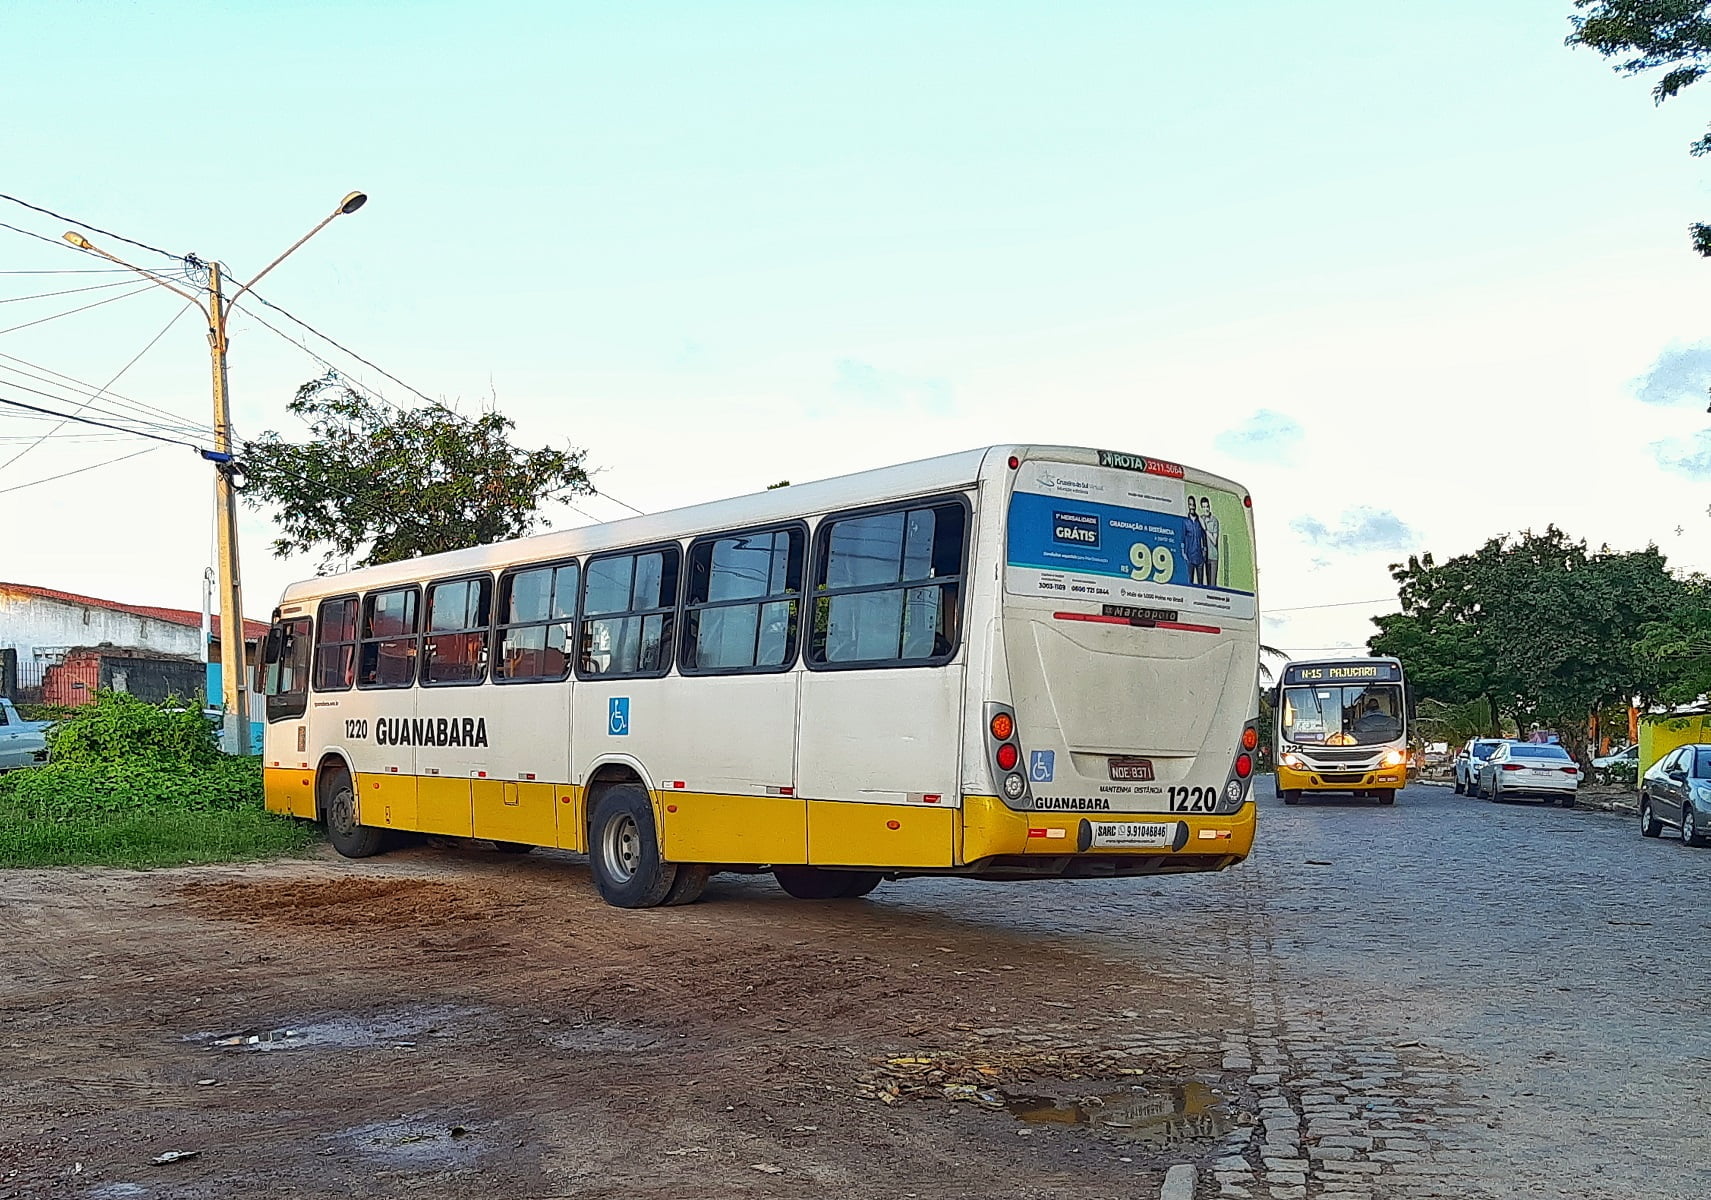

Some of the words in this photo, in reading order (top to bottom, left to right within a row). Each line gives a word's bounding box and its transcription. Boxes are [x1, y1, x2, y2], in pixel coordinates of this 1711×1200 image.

[1110, 520, 1143, 532] GRADUAÇÃO
[1130, 543, 1174, 584] 99
[1114, 608, 1176, 620] Marcopolo
[1302, 668, 1322, 679] N-15
[345, 719, 368, 739] 1220
[376, 717, 488, 747] GUANABARA
[1281, 745, 1304, 753] 1225
[1035, 797, 1110, 810] GUANABARA
[1167, 786, 1217, 812] 1220
[1098, 825, 1116, 837] SARC
